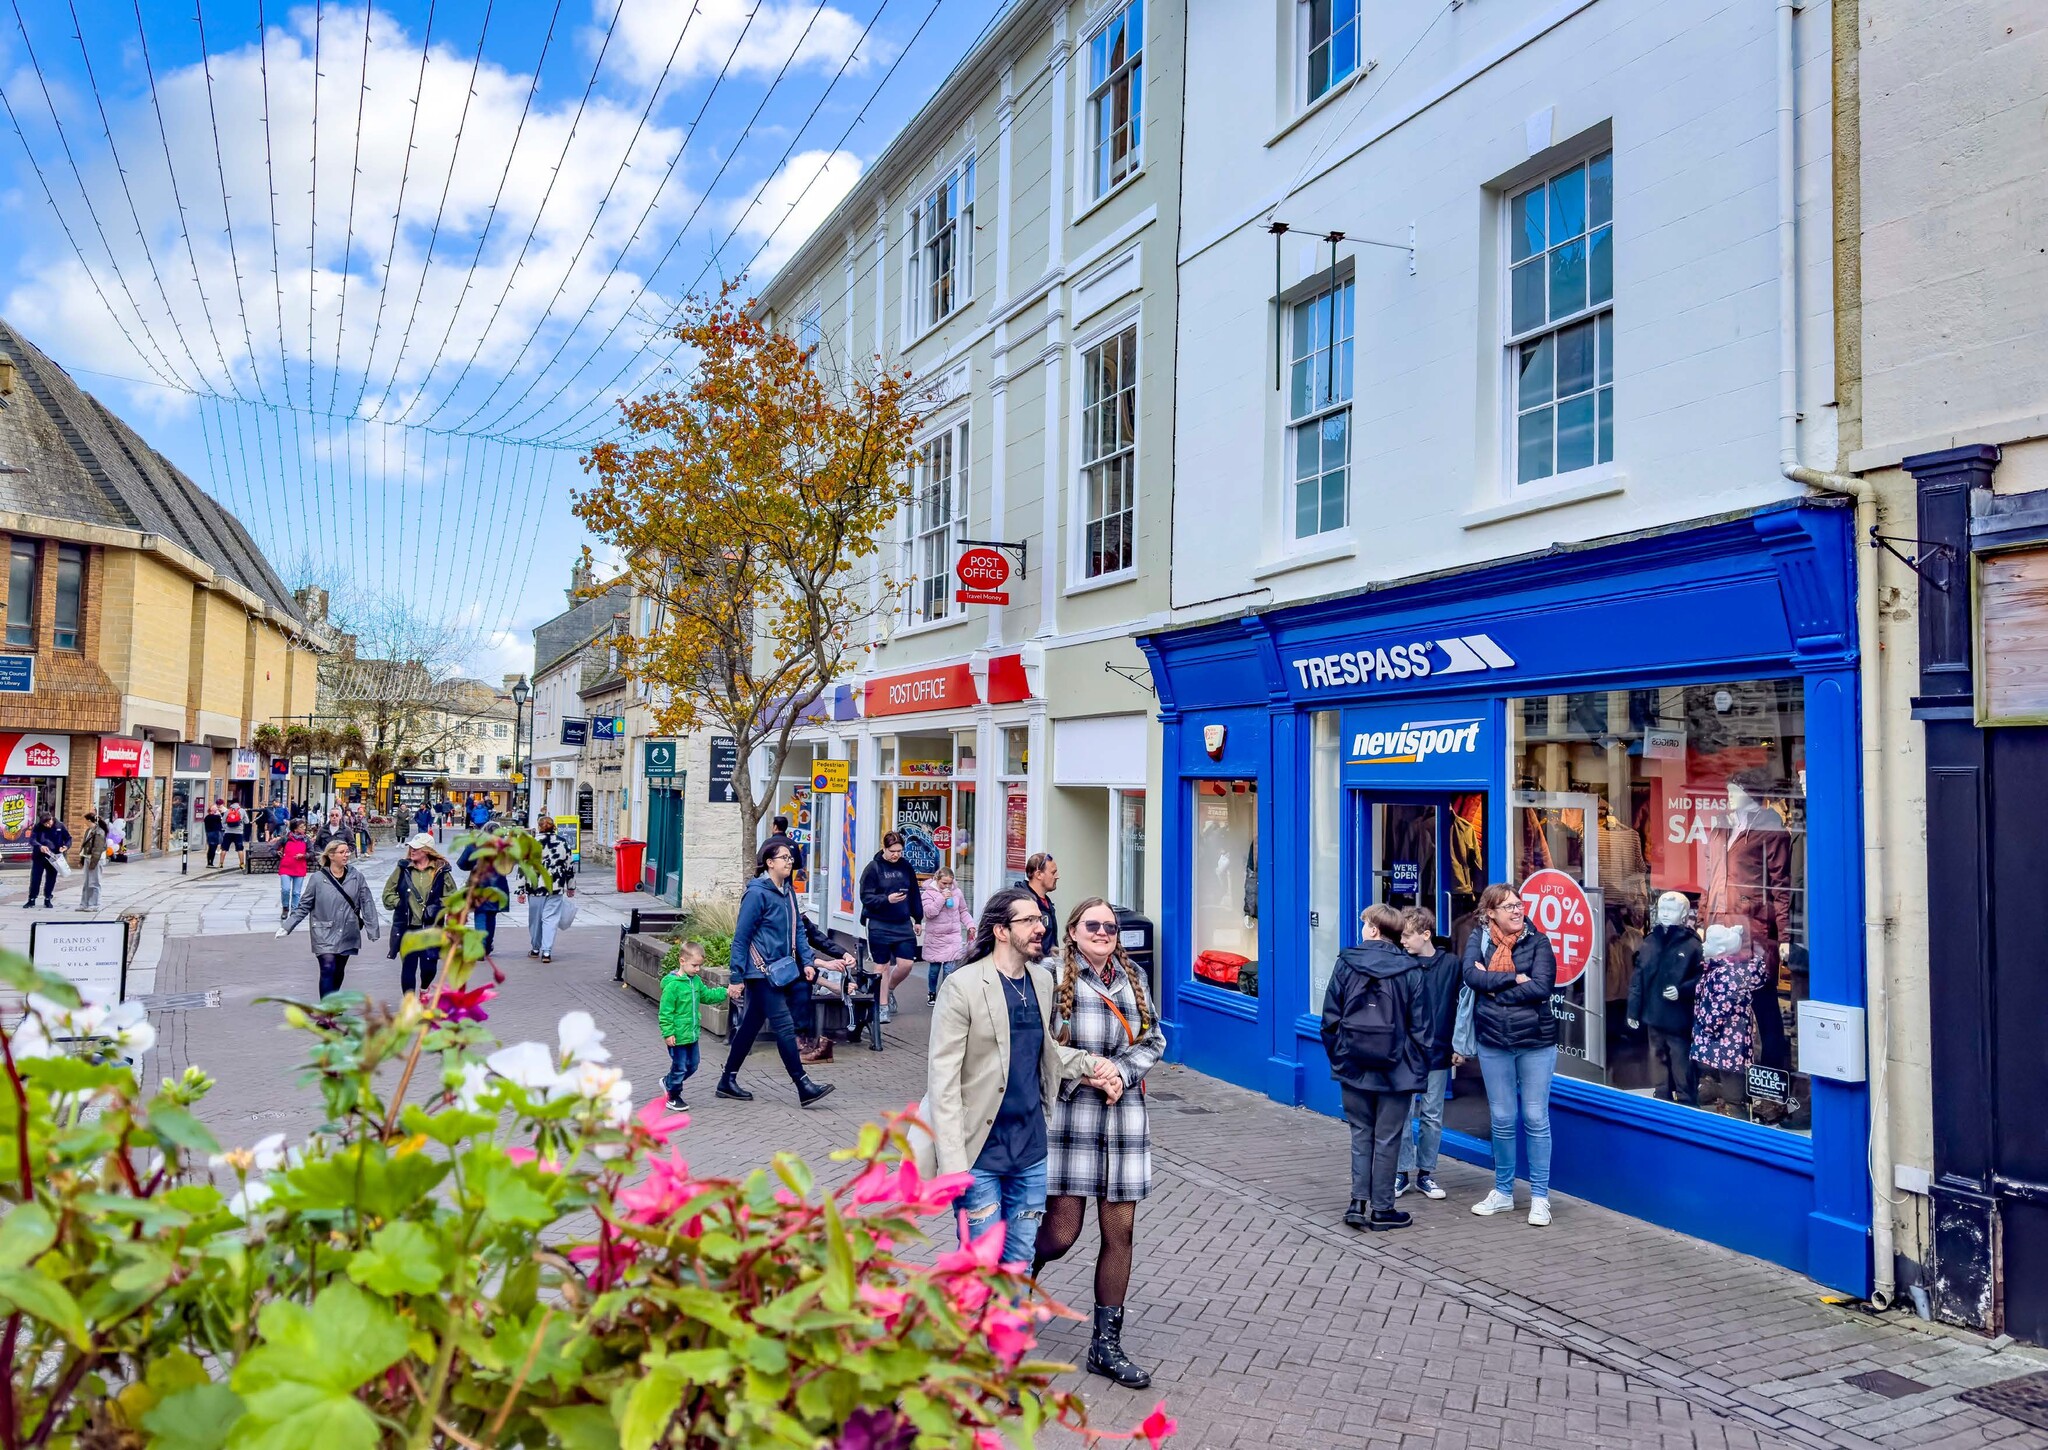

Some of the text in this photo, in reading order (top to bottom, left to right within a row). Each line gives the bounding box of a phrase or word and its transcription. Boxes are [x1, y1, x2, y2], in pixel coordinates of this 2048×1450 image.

[970, 556, 1000, 568] POST
[963, 568, 1003, 580] OFFICE
[983, 594, 1003, 602] Money
[889, 677, 946, 705] POST OFFICE
[1352, 722, 1479, 763] nevisport
[34, 749, 51, 757] Pet
[33, 757, 51, 765] Hut
[907, 801, 929, 810] DAN
[1668, 797, 1693, 810] MID
[898, 811, 938, 823] BROWN
[1393, 863, 1418, 872] WE'RE
[1393, 872, 1418, 880] OPEN
[1540, 884, 1565, 895] UP TO
[1521, 892, 1585, 931] 70%
[1833, 1022, 1841, 1031] 10
[1749, 1068, 1780, 1081] CLICK &
[1749, 1076, 1787, 1092] COLLECT
